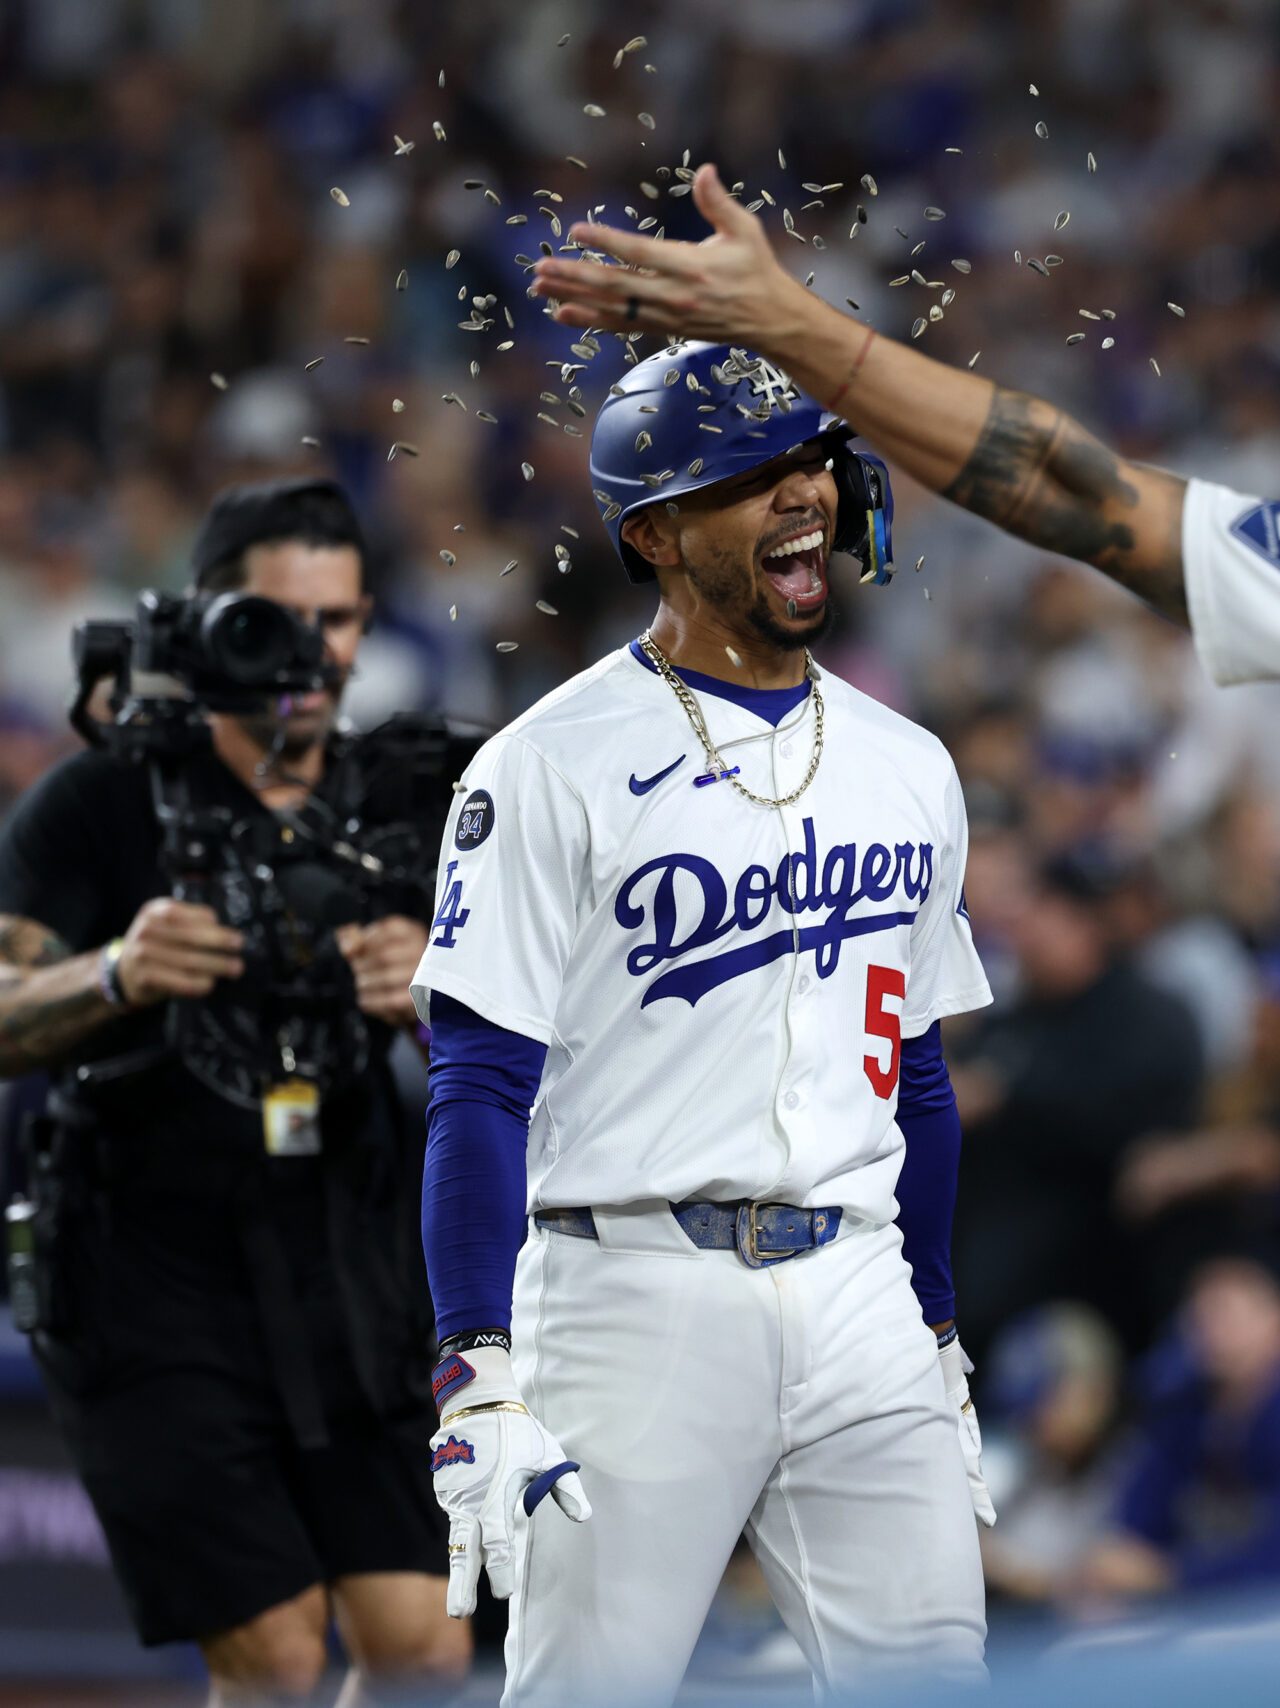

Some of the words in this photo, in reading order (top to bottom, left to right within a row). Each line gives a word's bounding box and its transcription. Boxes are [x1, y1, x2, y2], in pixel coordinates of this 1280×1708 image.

[460, 812, 482, 839] 34
[615, 816, 934, 980] Dodgers
[863, 963, 905, 1100] 5
